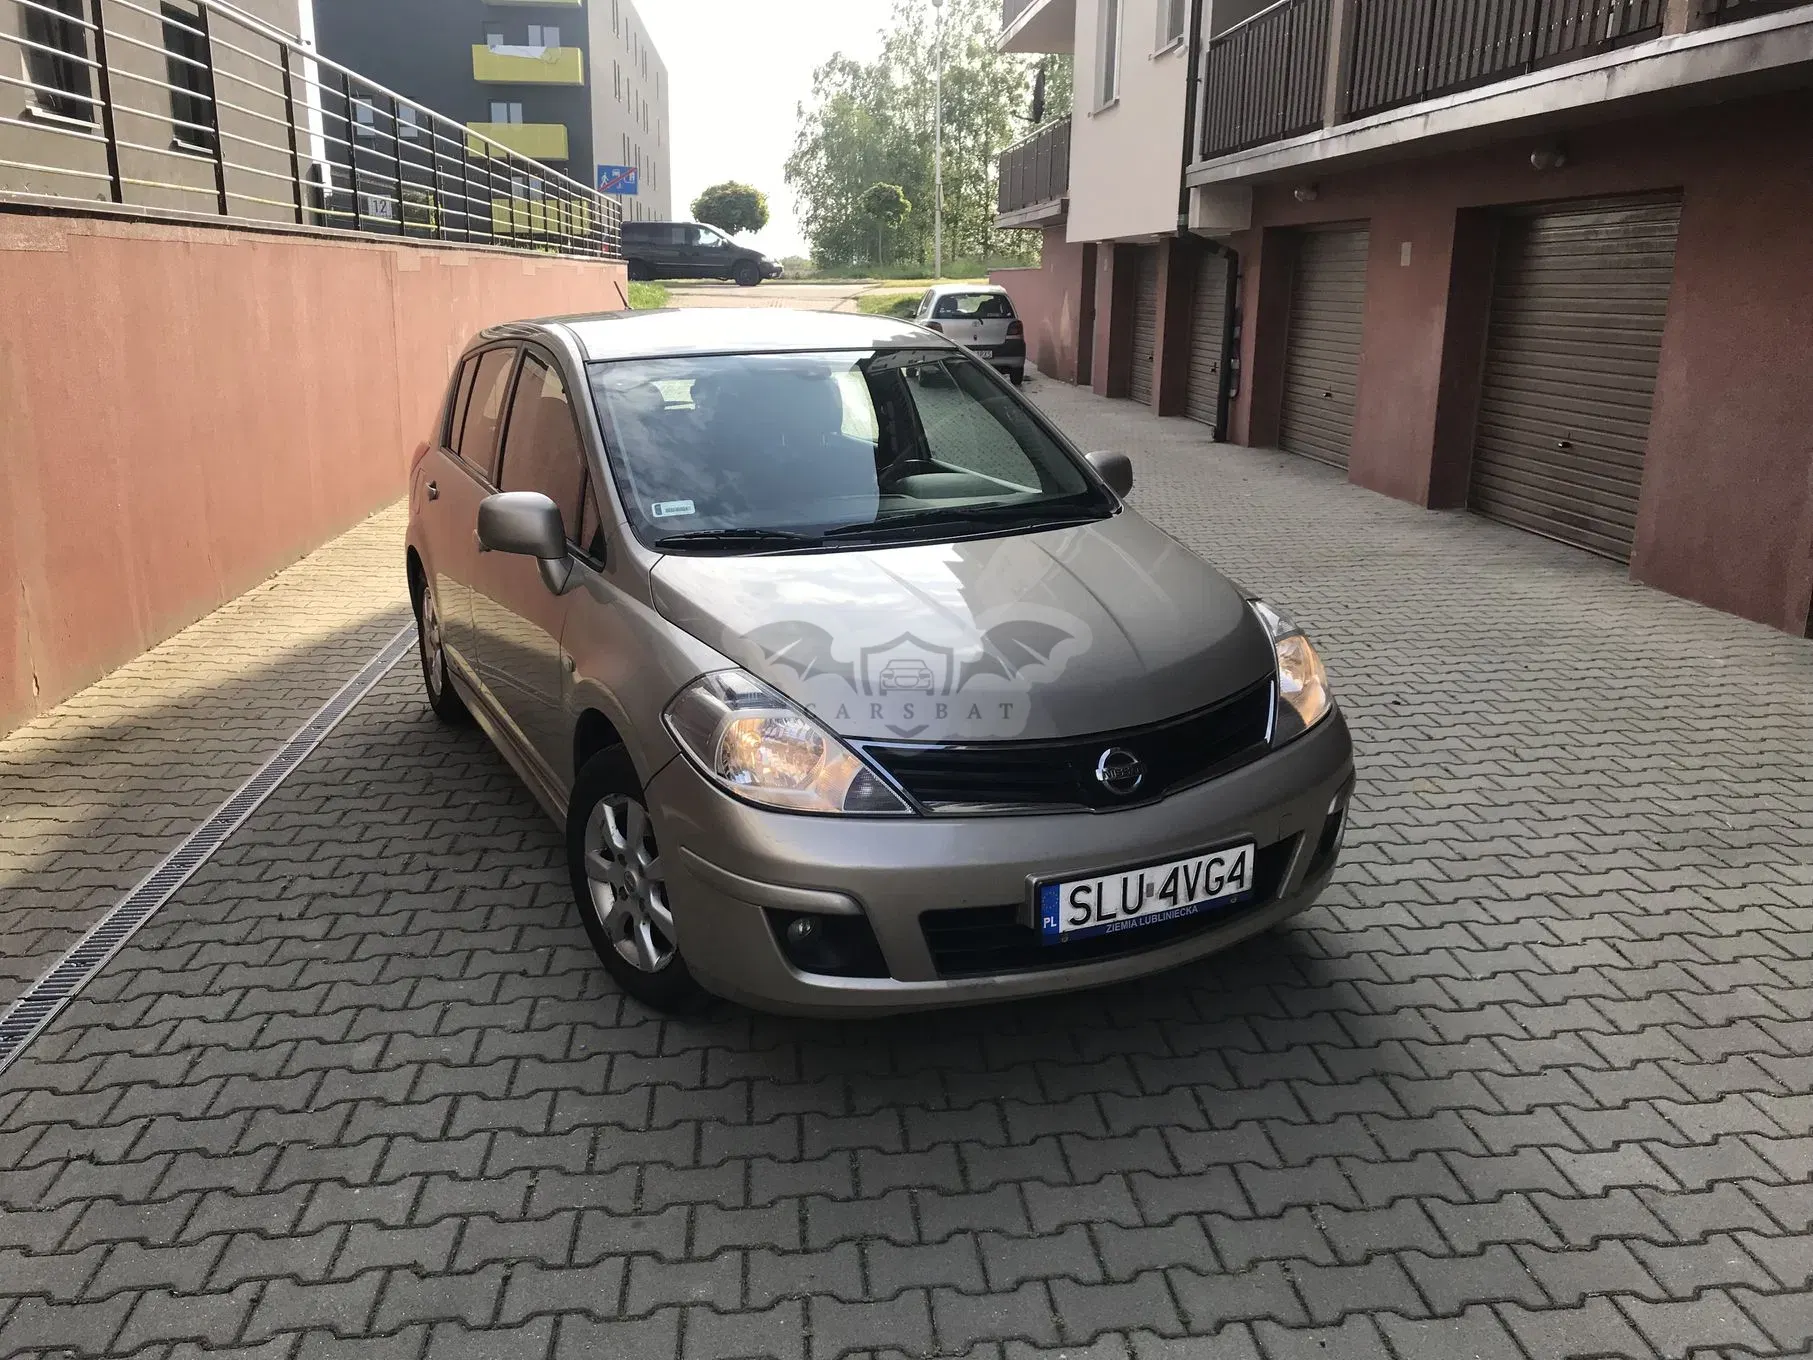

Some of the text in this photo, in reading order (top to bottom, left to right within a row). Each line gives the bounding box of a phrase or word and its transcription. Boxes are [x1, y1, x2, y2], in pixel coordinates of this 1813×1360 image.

[373, 199, 387, 213] 12
[1069, 850, 1247, 926] SLU 4VG4
[1043, 917, 1057, 929] PL
[1105, 904, 1199, 934] ZIEMIA LUBLINIECKA
